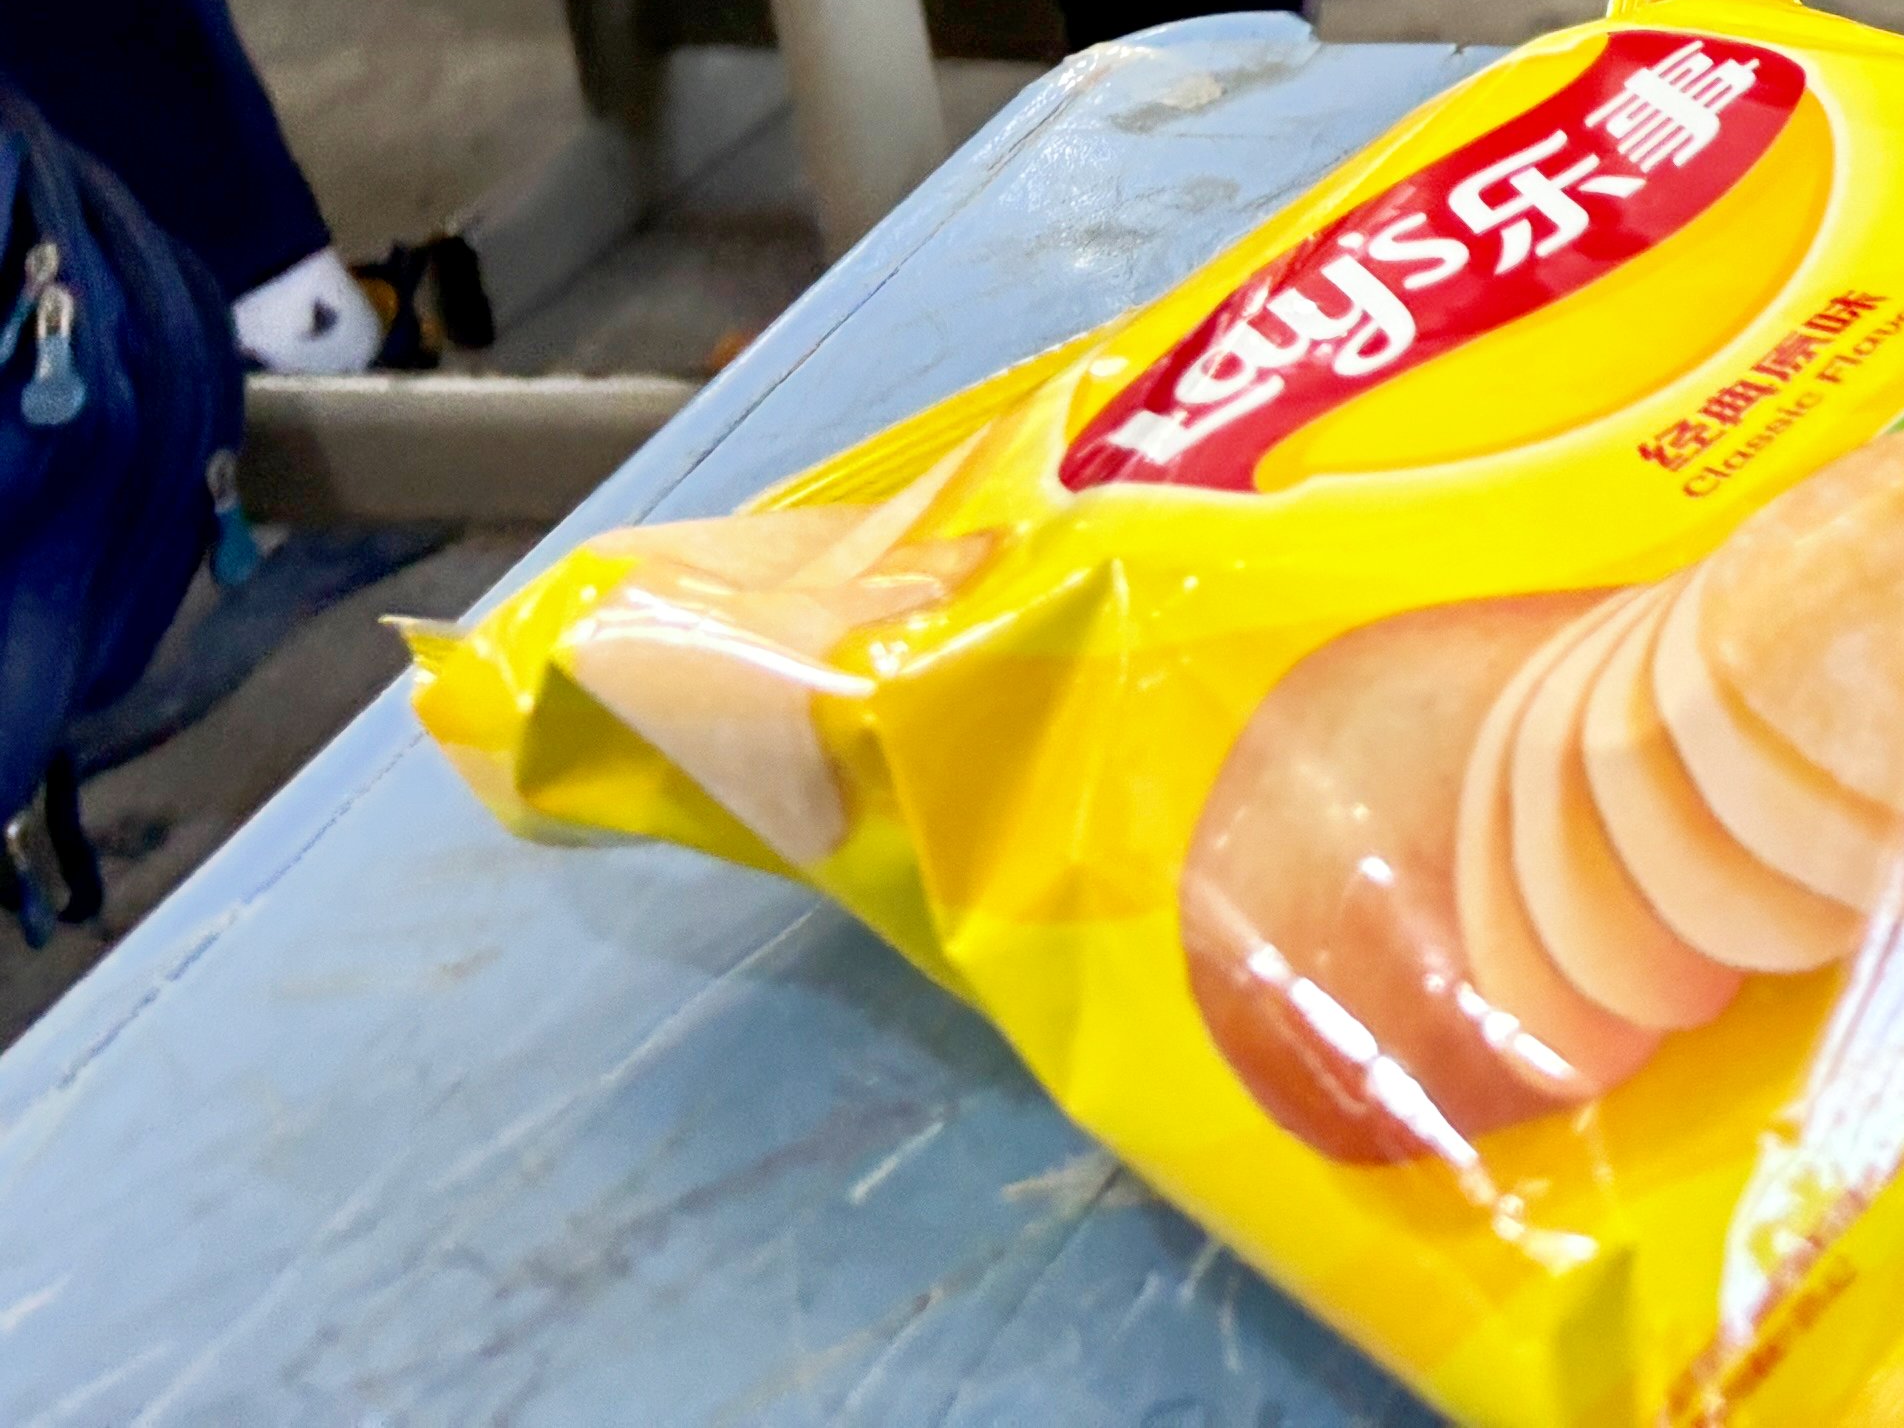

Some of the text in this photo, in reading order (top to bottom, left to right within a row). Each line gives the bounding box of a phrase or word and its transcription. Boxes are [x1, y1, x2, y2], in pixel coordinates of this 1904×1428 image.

[1448, 39, 1761, 275] 乐事
[1637, 290, 1887, 472] 经典原味
[1683, 390, 1824, 498] Classic
